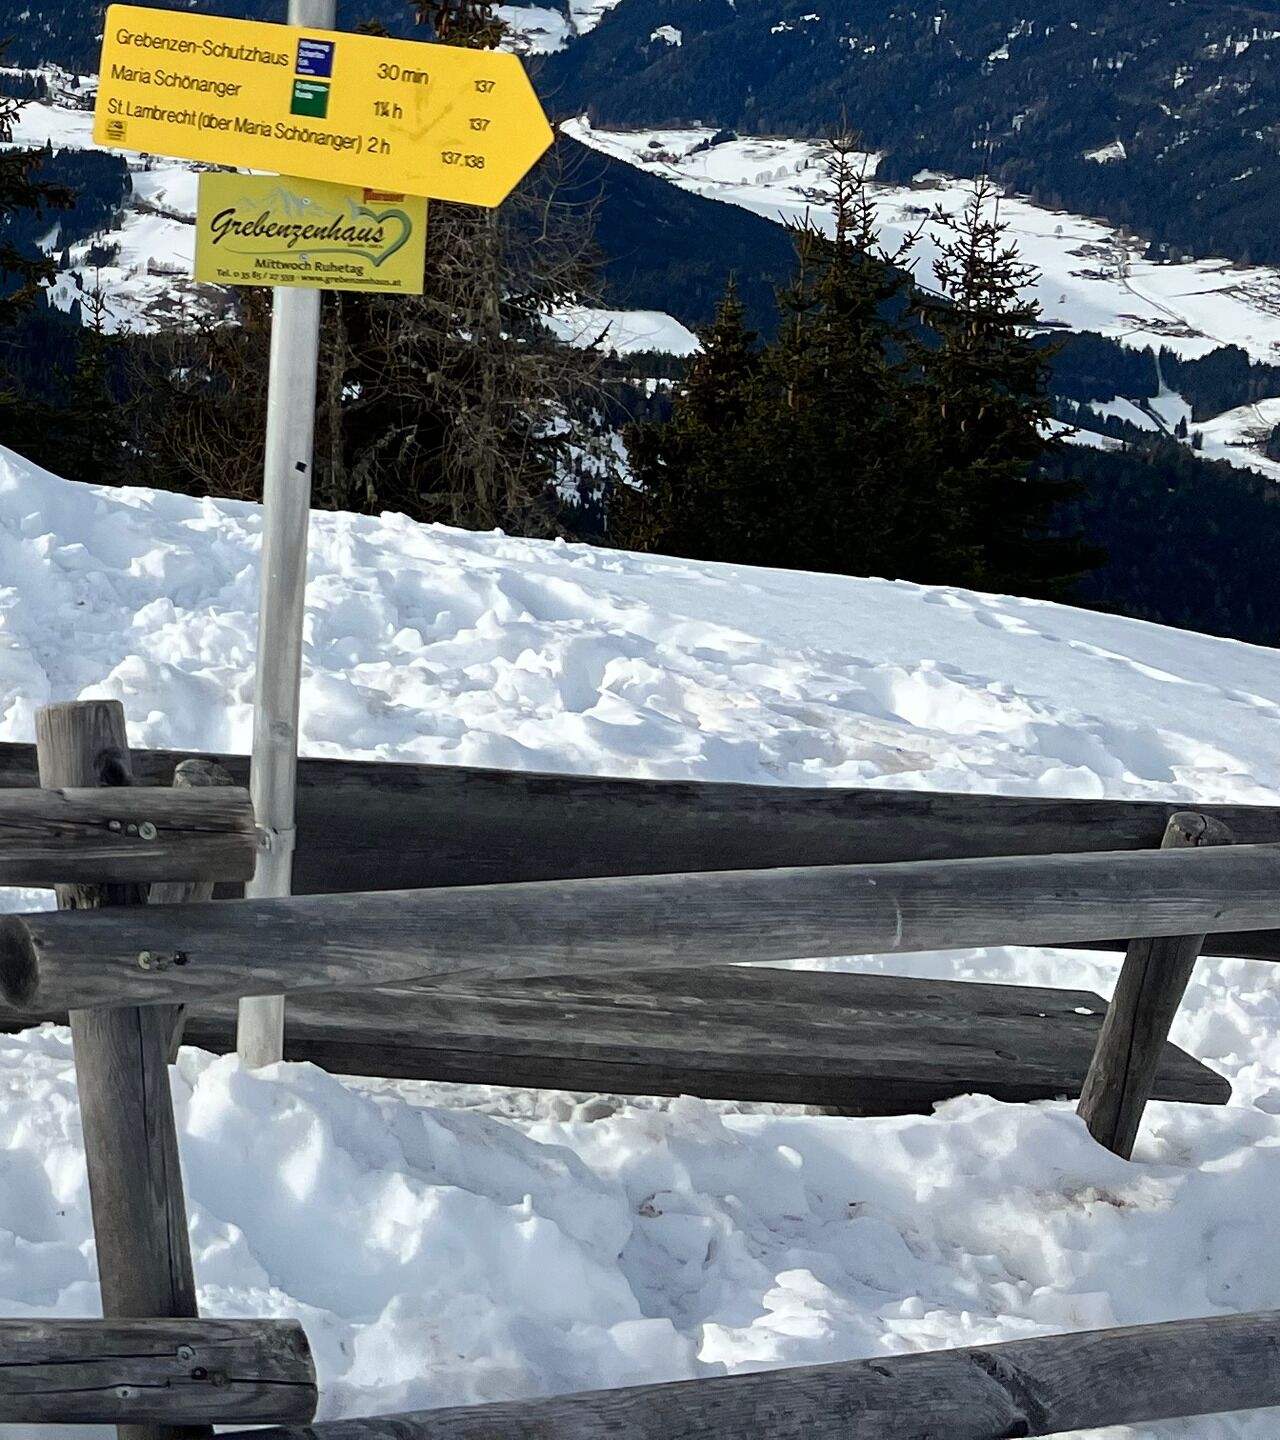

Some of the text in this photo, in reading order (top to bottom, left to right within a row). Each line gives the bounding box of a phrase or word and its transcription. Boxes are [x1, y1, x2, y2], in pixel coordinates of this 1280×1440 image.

[116, 28, 289, 66] Grebenzen-Schutzhaus
[377, 63, 400, 80] 30
[401, 67, 429, 85] min
[474, 80, 496, 93] 137
[111, 64, 150, 84] Maria
[153, 69, 242, 98] Schönanger
[469, 118, 491, 131] 137
[126, 101, 197, 126] Lambrecht
[197, 112, 233, 131] (über
[234, 117, 272, 137] Maria
[274, 122, 363, 154] Schönanger)
[210, 208, 385, 248] Grebenzenhaus
[254, 258, 364, 276] Mittwoch Ruhetag
